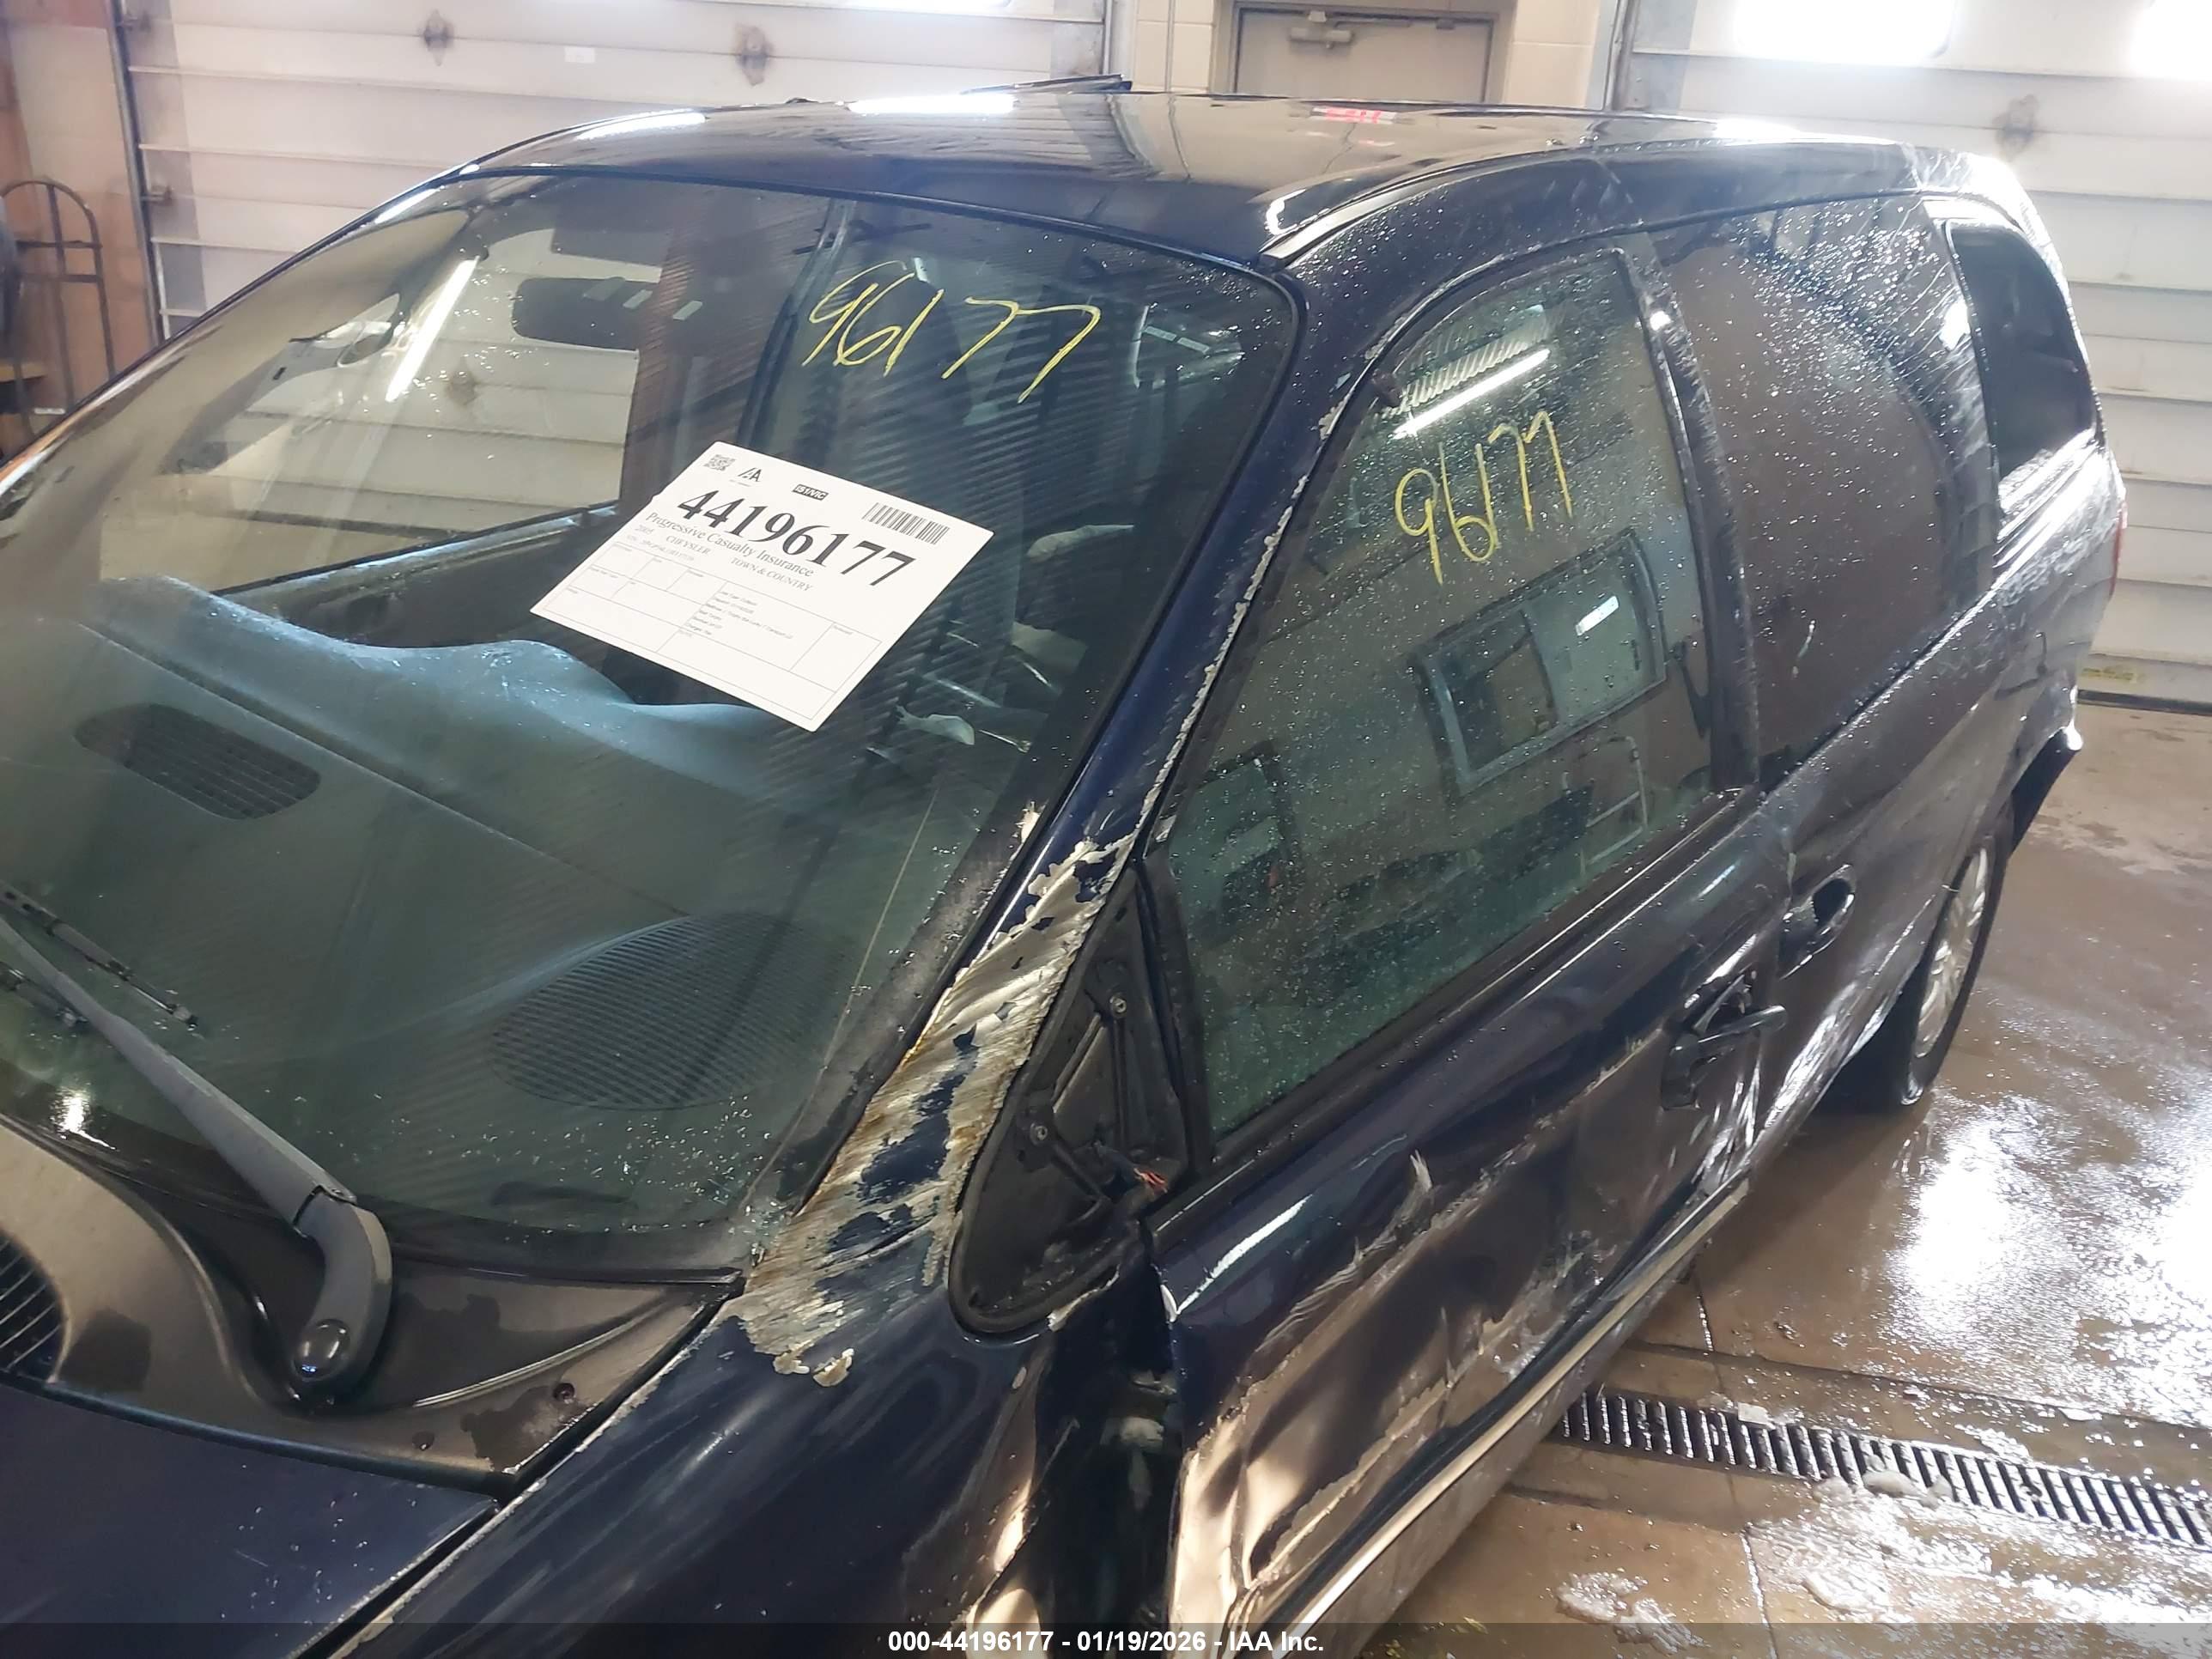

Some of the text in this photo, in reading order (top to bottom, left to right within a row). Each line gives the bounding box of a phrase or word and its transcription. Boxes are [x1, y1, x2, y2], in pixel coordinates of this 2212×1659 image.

[802, 259, 1102, 404] 96177
[646, 512, 707, 539] Progressive
[708, 532, 756, 557] Casualty
[757, 549, 814, 578] Insurance
[678, 489, 916, 586] 44196177
[1395, 410, 1573, 586] 96177
[766, 569, 814, 592] COUNTRY
